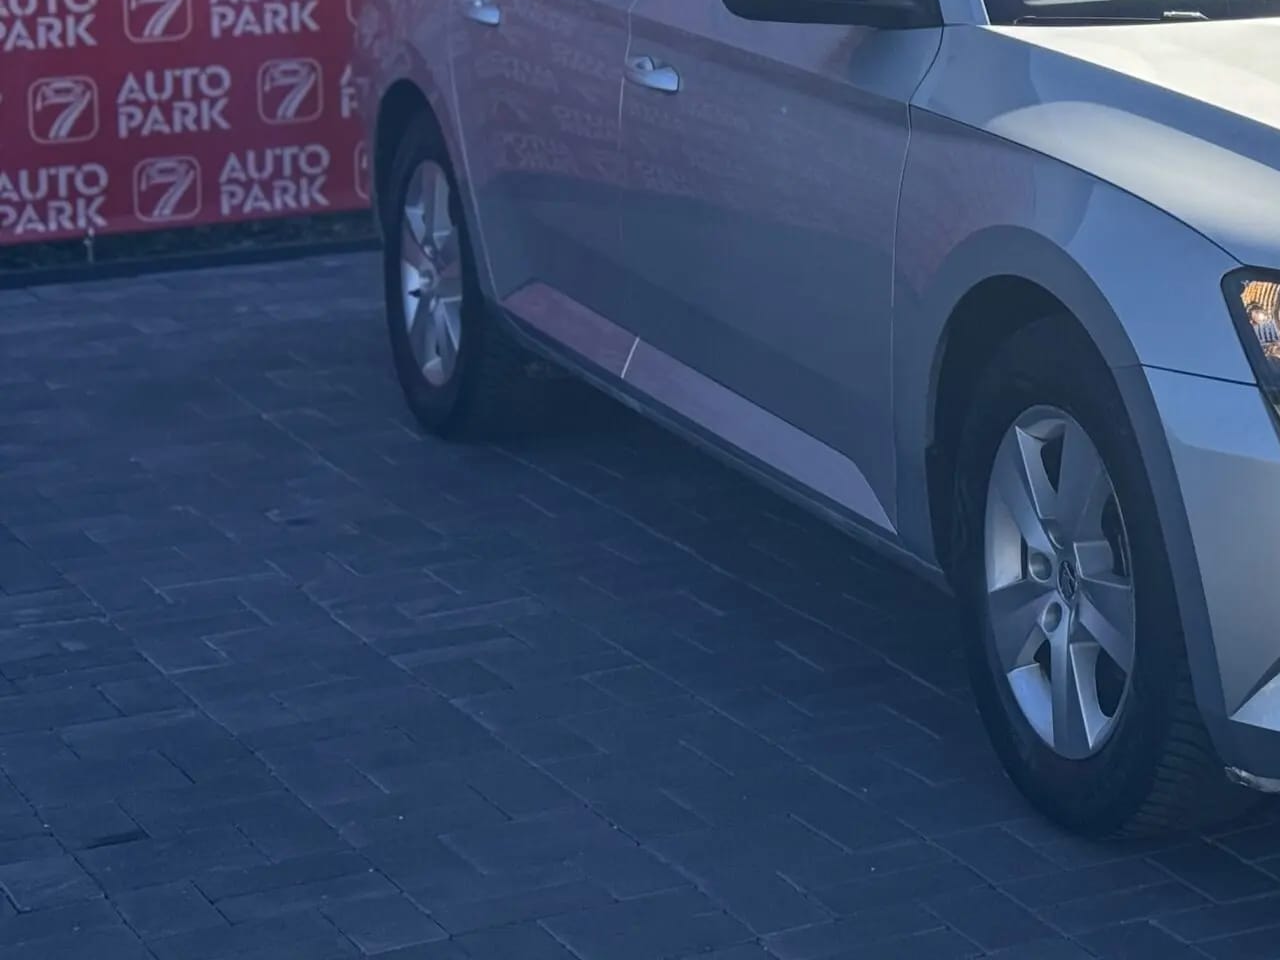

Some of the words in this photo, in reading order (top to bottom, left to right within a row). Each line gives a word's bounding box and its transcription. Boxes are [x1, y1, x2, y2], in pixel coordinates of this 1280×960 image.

[0, 14, 95, 51] ARK
[211, 0, 318, 37] PARK
[118, 65, 230, 104] AUTO
[118, 98, 229, 137] PARK
[219, 144, 330, 183] AUTO
[221, 175, 329, 216] PARK
